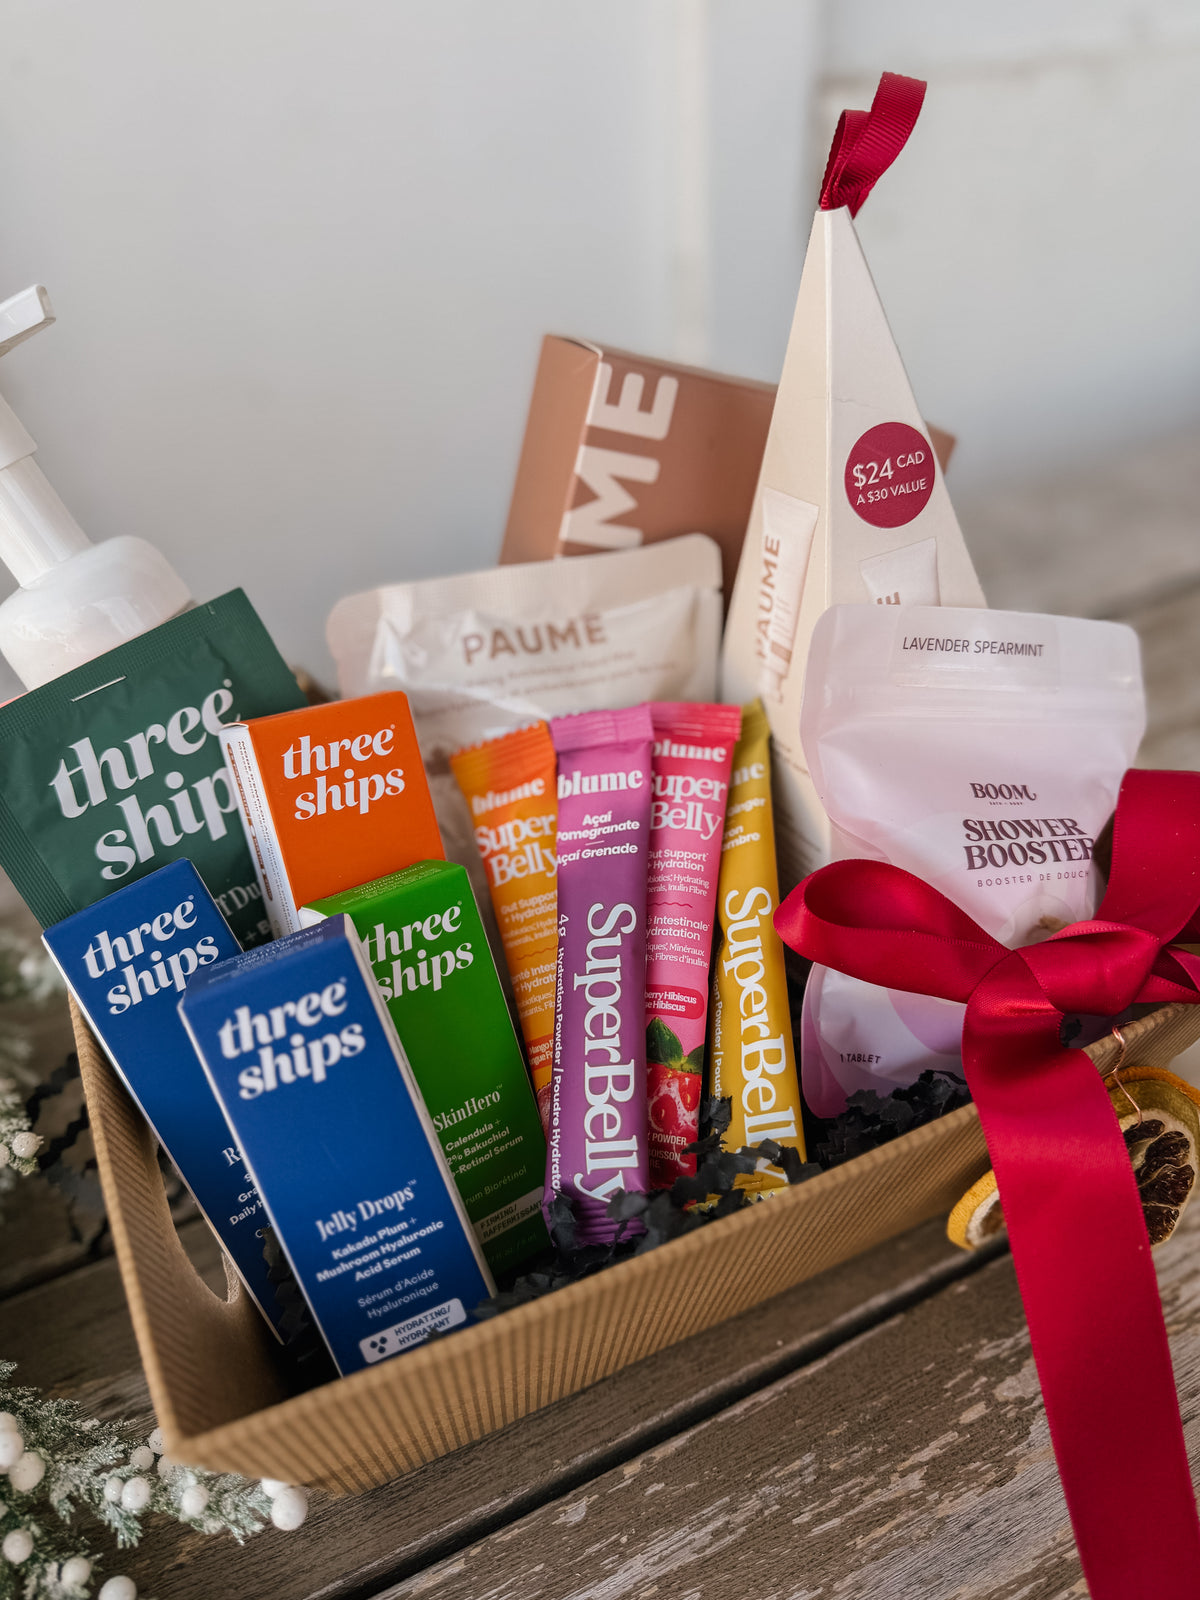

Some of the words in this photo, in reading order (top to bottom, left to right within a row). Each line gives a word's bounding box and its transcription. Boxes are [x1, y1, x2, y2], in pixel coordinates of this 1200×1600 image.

[558, 361, 679, 550] ME
[852, 457, 895, 490] $24
[896, 451, 925, 469] CAD
[856, 494, 866, 506] A
[867, 488, 888, 504] $30
[890, 478, 927, 497] VALUE
[462, 613, 608, 667] PAUME
[902, 637, 970, 653] LAVENDER
[973, 640, 1044, 657] SPEARMINT
[48, 688, 241, 819] three
[281, 728, 395, 779] three
[294, 767, 406, 820] ships
[471, 777, 546, 816] blume
[557, 770, 643, 800] blume
[969, 782, 1037, 802] BOOM
[95, 767, 240, 881] ship
[474, 814, 556, 858] Super
[650, 801, 723, 840] Belly
[962, 818, 1087, 842] SHOWER
[489, 842, 558, 888] Belly
[581, 843, 638, 859] Grenade
[653, 860, 704, 872] Hydration
[664, 849, 707, 861] Support
[228, 882, 262, 910] Du
[977, 875, 1033, 888] BOOSTER
[81, 900, 198, 979] three
[360, 906, 462, 966] three
[646, 927, 701, 941] ydratation
[654, 916, 710, 931] Intestinale
[106, 936, 219, 1015] ships
[530, 962, 557, 976] Intes
[556, 947, 565, 1013] Hydration
[644, 991, 664, 1003] berry
[664, 991, 697, 1004] Hibiscus
[652, 1000, 685, 1012] Hibiscus
[217, 982, 348, 1060] three
[554, 1013, 564, 1065] Powder
[238, 1023, 366, 1100] ships
[573, 902, 640, 1204] SuperBelly
[846, 1053, 881, 1063] TABLET
[552, 1074, 562, 1127] Poudre
[445, 1122, 494, 1151] Calendula
[463, 1126, 511, 1158] Bakuchiol
[494, 1134, 524, 1155] Serum
[229, 1204, 257, 1226] Daily
[315, 1210, 358, 1242] Jelly
[315, 1250, 381, 1283] Mushroom
[380, 1220, 444, 1254] Hyaluronic
[331, 1234, 378, 1260] Kakadu
[377, 1221, 409, 1240] Plum
[409, 1216, 418, 1225] +
[354, 1262, 383, 1283] Acid
[382, 1247, 422, 1269] Serum
[357, 1286, 394, 1308] Sérum
[394, 1267, 436, 1292] d'Acide
[366, 1281, 440, 1319] Hyaluronique
[394, 1305, 451, 1336] HYDRATING/
